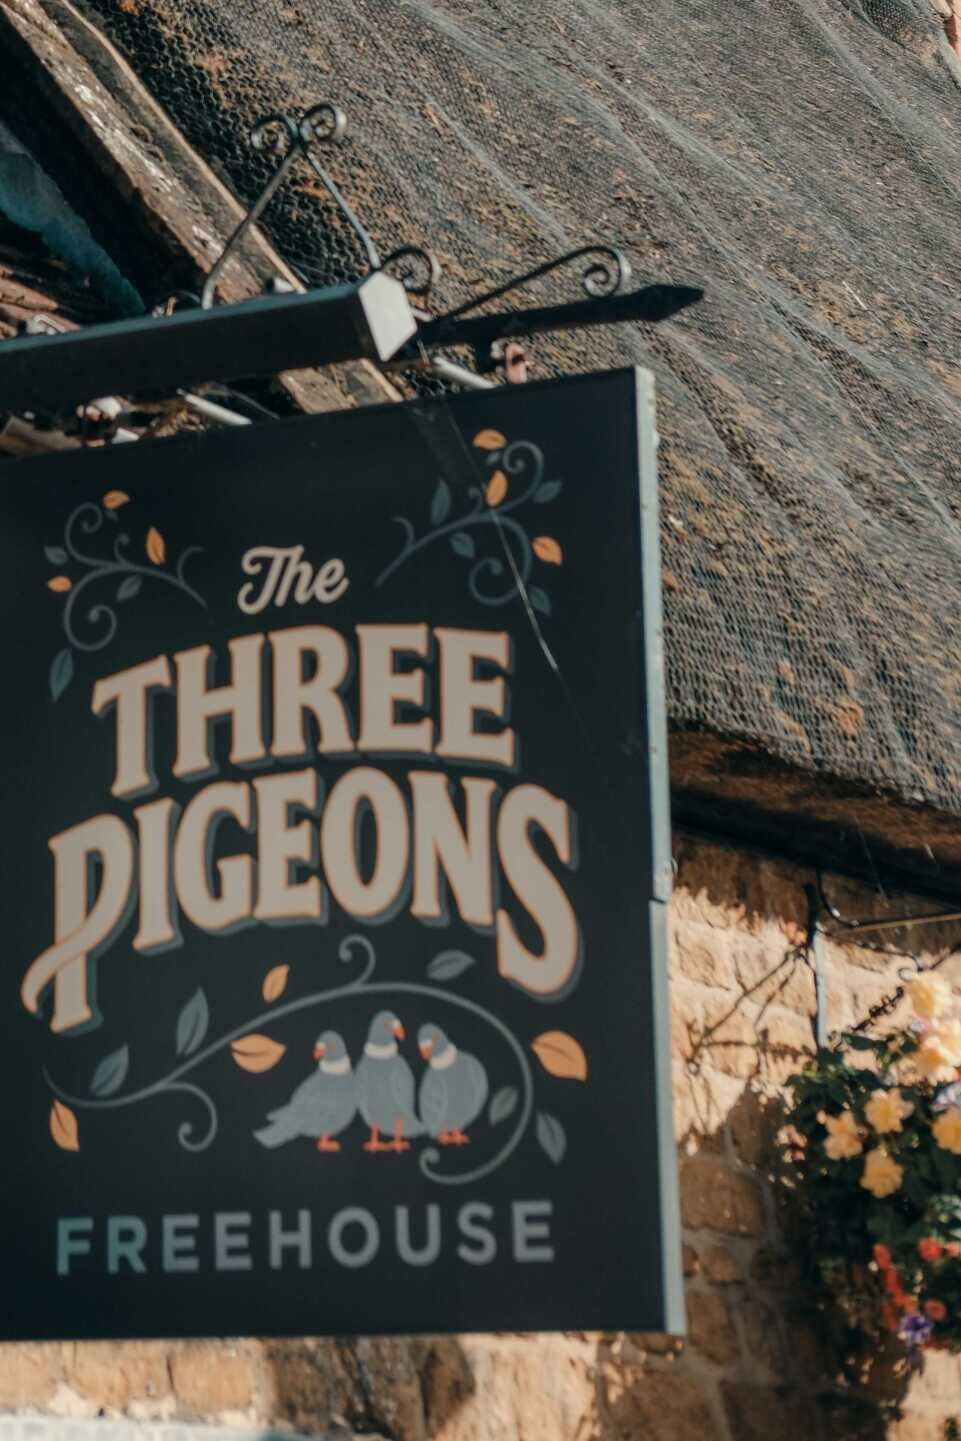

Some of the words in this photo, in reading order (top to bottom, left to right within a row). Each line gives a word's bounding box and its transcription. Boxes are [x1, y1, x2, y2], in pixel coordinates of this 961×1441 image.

[238, 545, 348, 614] The
[91, 622, 518, 800] THREE
[21, 766, 580, 1034] PIGEONS
[56, 1200, 555, 1275] FREEHOUSE
